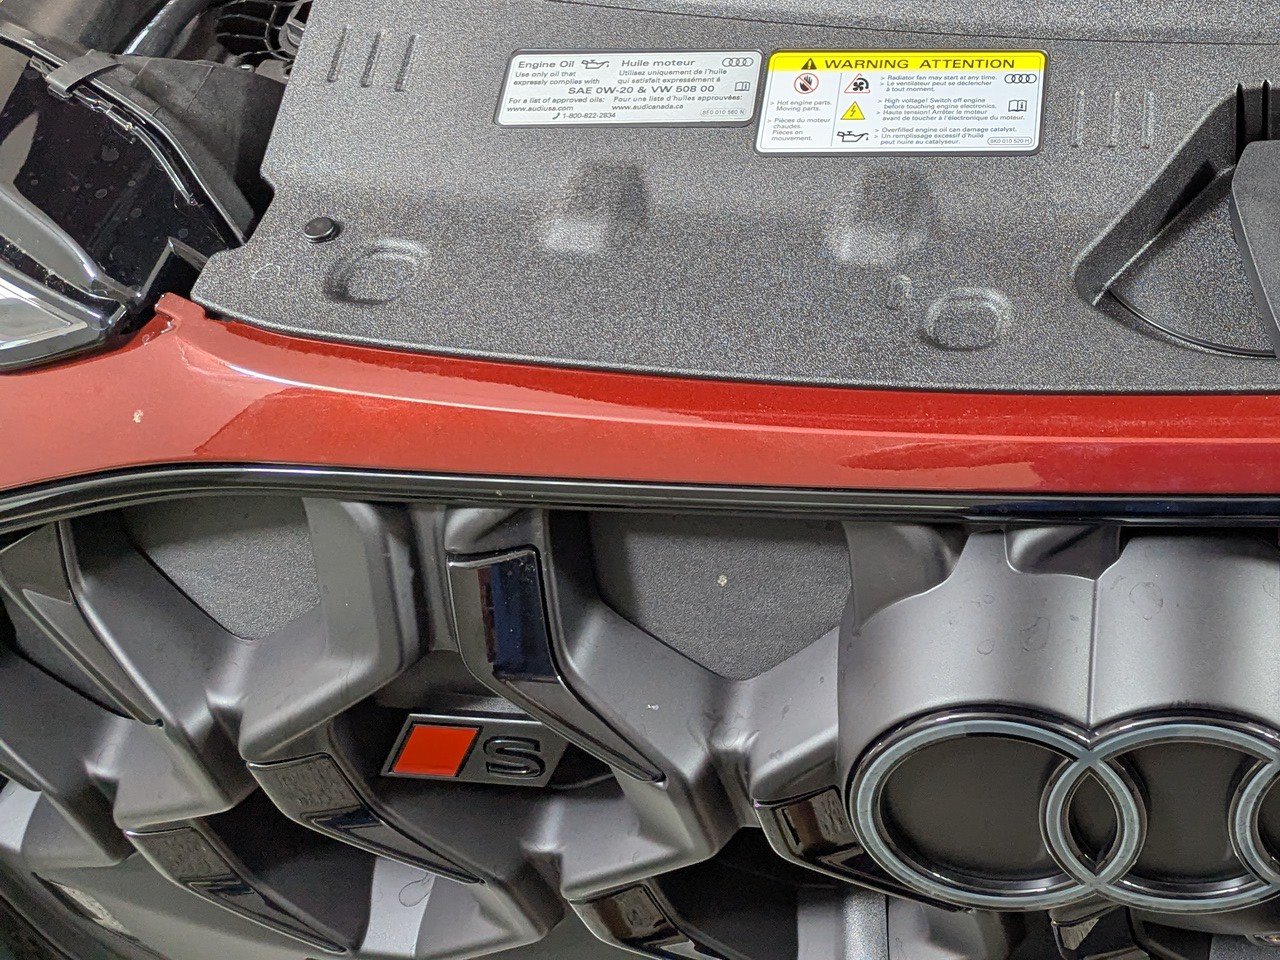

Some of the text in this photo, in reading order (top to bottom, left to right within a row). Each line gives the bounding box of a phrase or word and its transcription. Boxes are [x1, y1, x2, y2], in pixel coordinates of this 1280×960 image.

[518, 60, 575, 69] Engine Oil
[825, 59, 1015, 69] WARNING ATTENTION
[596, 86, 634, 94] 0W-20
[637, 86, 647, 94] &
[552, 97, 588, 105] approved
[697, 94, 743, 102] approuvées:
[483, 736, 546, 779] S
